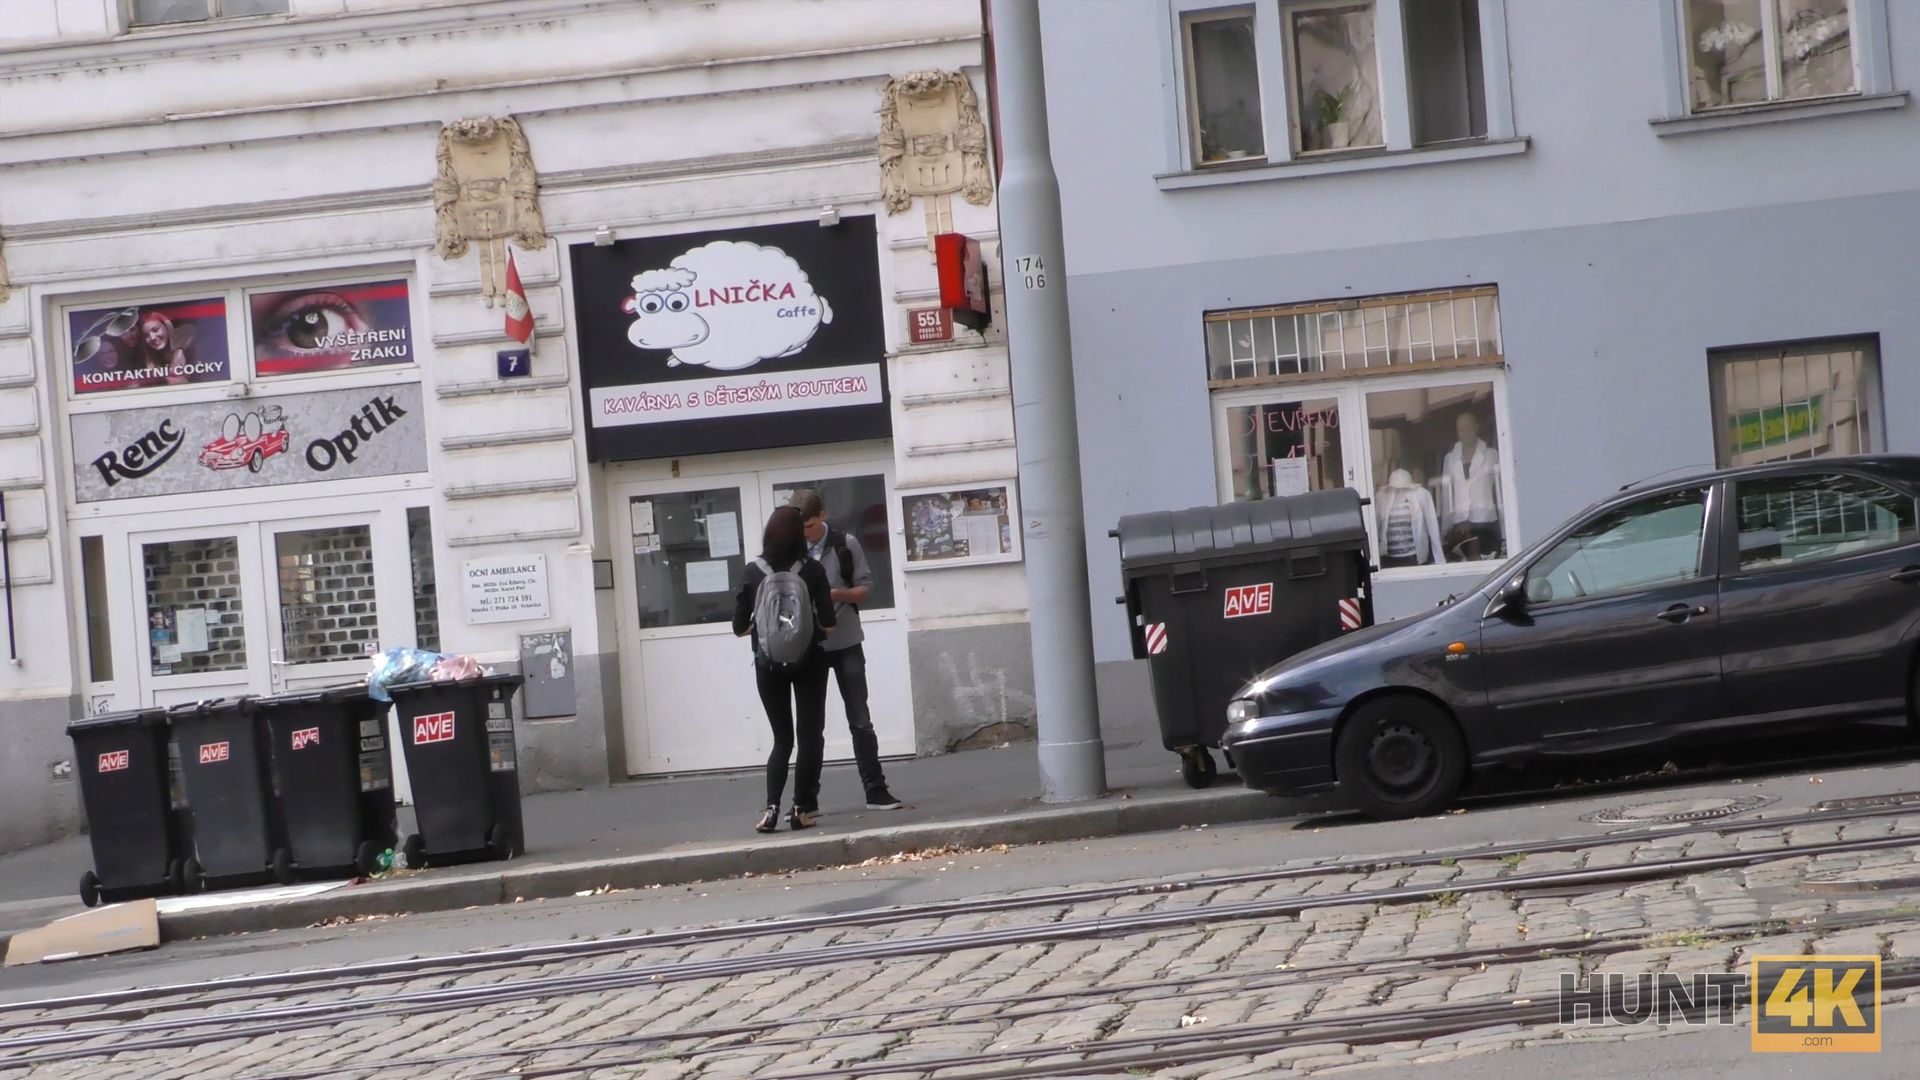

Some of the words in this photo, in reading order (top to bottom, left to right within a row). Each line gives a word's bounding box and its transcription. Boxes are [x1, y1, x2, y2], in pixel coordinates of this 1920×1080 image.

[1016, 256, 1044, 272] 174
[1025, 274, 1046, 289] 06
[694, 279, 796, 307] LNIČKA
[776, 306, 817, 319] Caffe
[918, 310, 941, 327] 551
[350, 345, 407, 361] ZRAKU
[508, 355, 518, 372] 7
[82, 364, 170, 384] KONTAKTNÍ
[604, 391, 681, 415] KAVÁRNA
[687, 393, 699, 408] S
[704, 380, 782, 406] DĚTSKÝM
[787, 376, 867, 399] KOUTKEM
[305, 395, 407, 473] Optik
[91, 418, 186, 487] Renc
[469, 568, 489, 578] OČNÍ
[490, 565, 537, 576] AMBULANCE
[1226, 591, 1270, 612] AVE
[417, 719, 452, 738] AVE
[293, 731, 318, 749] AVE
[100, 754, 127, 770] AVE
[201, 747, 228, 762] AVE
